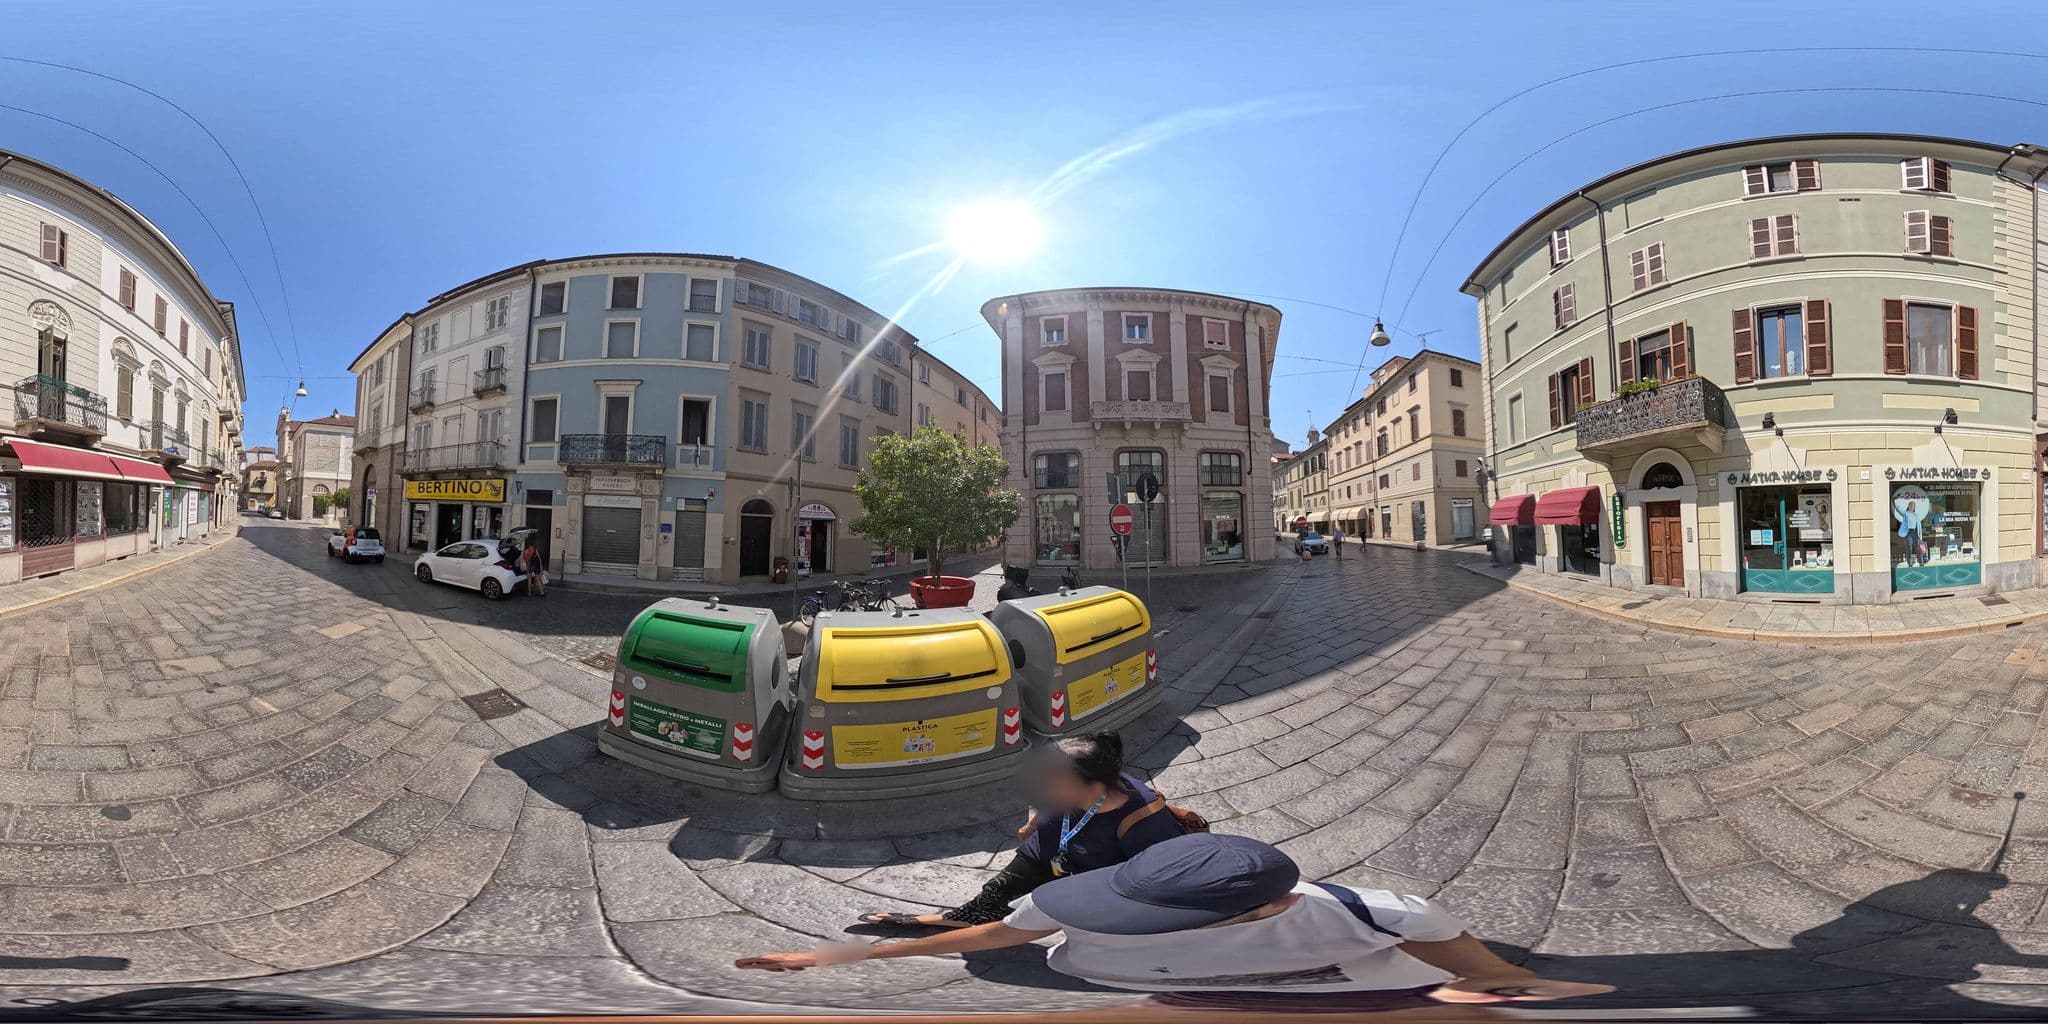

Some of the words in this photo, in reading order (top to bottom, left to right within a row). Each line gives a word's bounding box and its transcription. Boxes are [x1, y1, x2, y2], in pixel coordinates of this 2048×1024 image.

[1741, 471, 1780, 484] NATUR
[1781, 470, 1822, 483] HOUSE
[1900, 467, 1939, 480] NATUR
[1941, 467, 1979, 480] HOUSE
[417, 480, 482, 494] BERTINO
[1103, 668, 1120, 677] PLASTICA
[633, 700, 668, 715] IMBALLAGGI
[668, 711, 690, 721] VETRO
[694, 718, 722, 728] METALLI
[902, 723, 938, 732] PLASTICA
